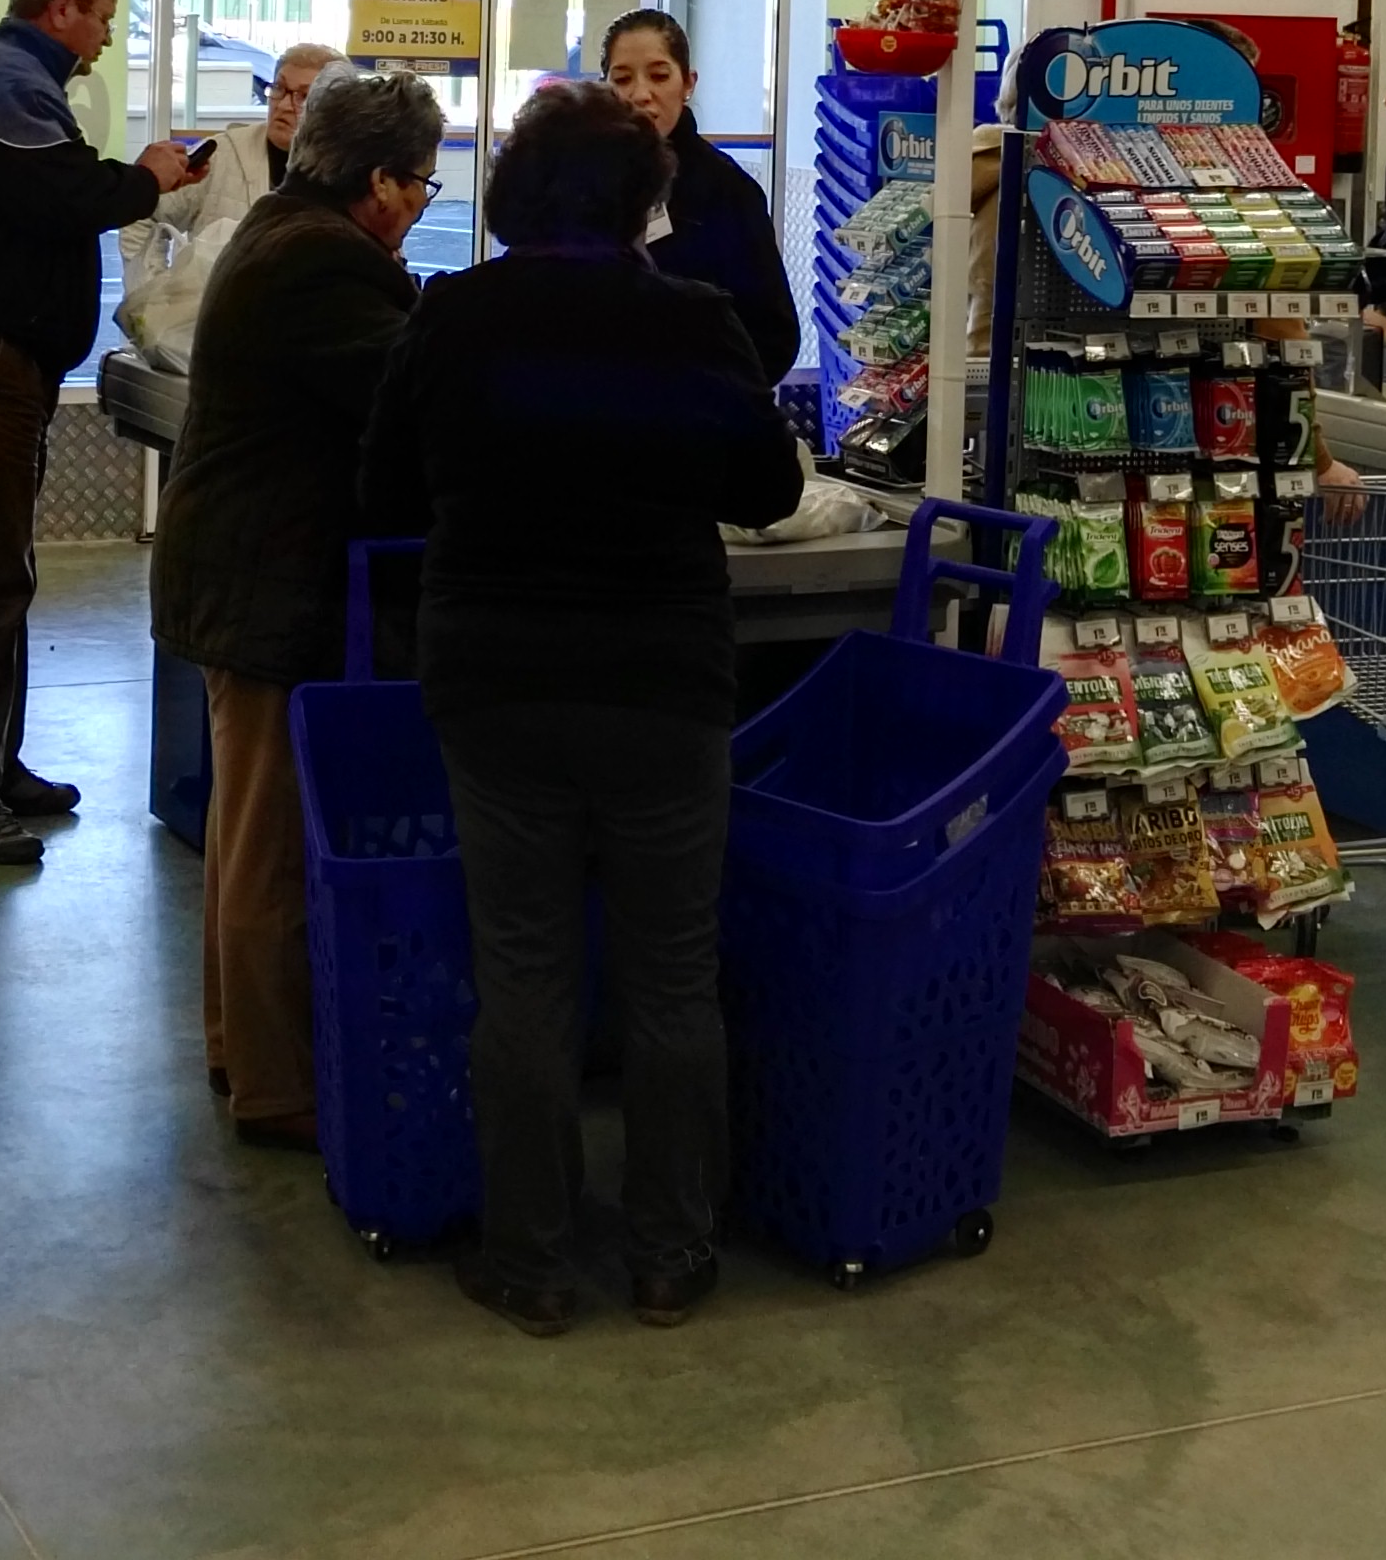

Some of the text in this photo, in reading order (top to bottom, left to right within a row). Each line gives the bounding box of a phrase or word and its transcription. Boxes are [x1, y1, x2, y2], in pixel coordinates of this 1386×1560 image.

[362, 29, 465, 46] 9:00 a 21:30 H.
[1043, 50, 1180, 102] Orbit
[1138, 100, 1164, 111] PARA
[1193, 100, 1235, 112] DIENTES
[889, 129, 935, 160] Orbit
[1058, 212, 1108, 282] Orbit
[1090, 401, 1124, 416] Orbit
[1222, 405, 1254, 422] Orbit
[1085, 530, 1119, 542] Trident
[1149, 525, 1184, 537] Trident
[1213, 539, 1250, 553] senses
[1066, 678, 1118, 694] ENTOLIN
[1134, 806, 1199, 835] ARIBO
